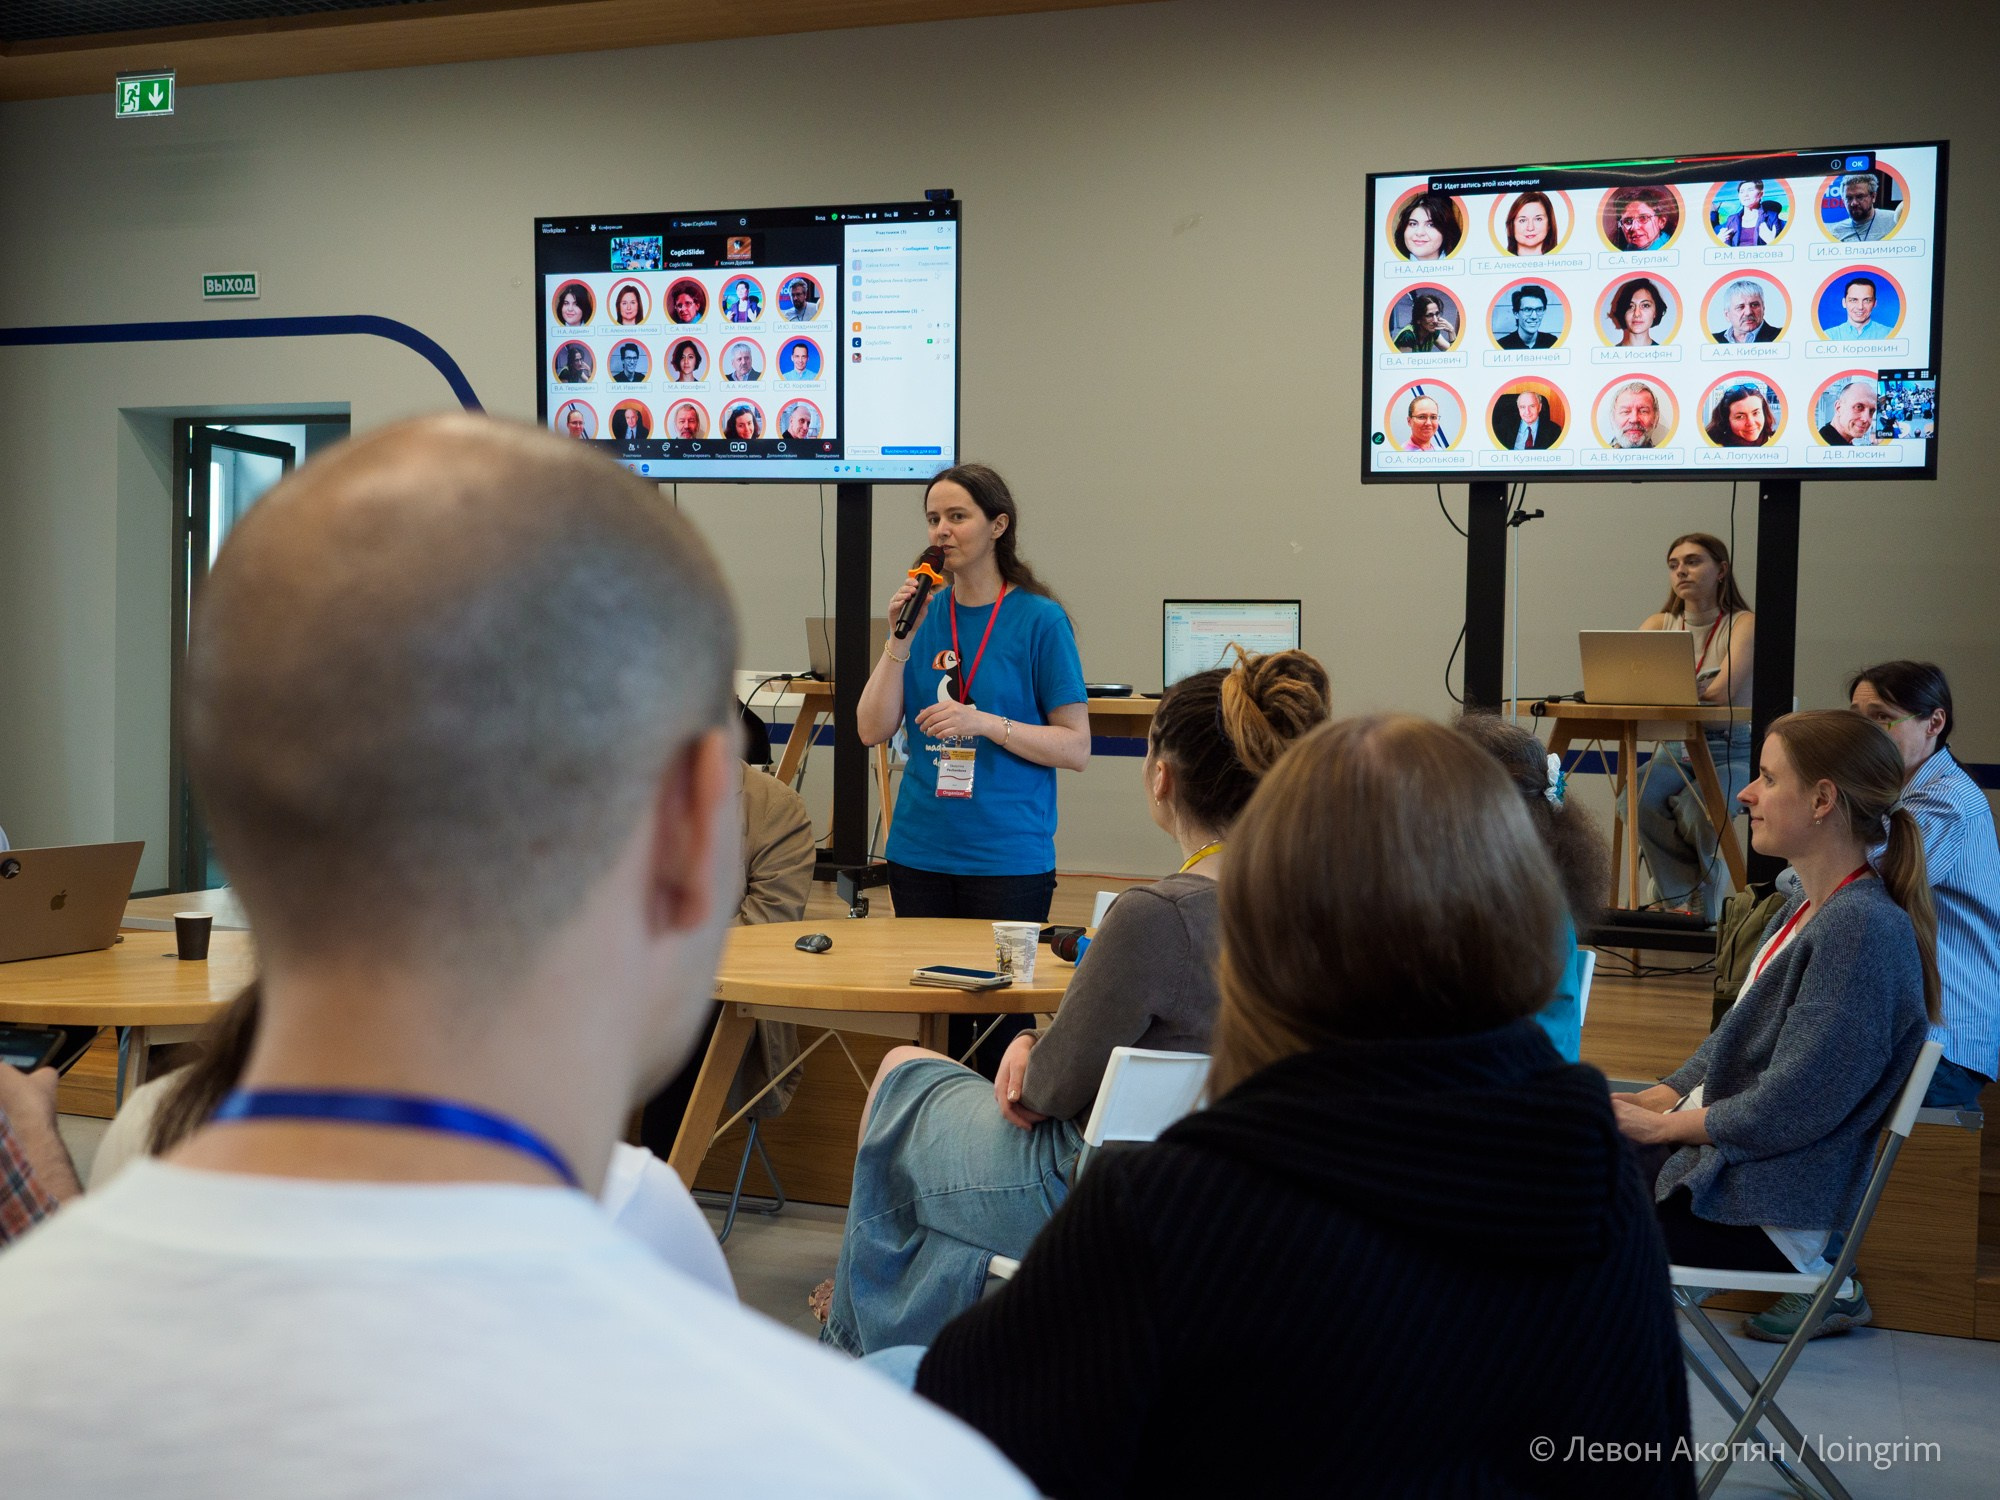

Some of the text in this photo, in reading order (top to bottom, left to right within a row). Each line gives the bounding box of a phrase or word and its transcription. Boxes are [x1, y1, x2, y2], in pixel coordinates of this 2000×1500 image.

[1444, 182, 1459, 190] Идет
[1497, 179, 1540, 188] конференции
[1738, 251, 1783, 259] Власова
[1845, 245, 1917, 256] Владимиров
[1631, 255, 1668, 265] Бурлак
[1416, 265, 1454, 274] Адамян
[1494, 260, 1583, 270] Алексеева-Нилова
[206, 278, 254, 293] ВЫХОД
[1736, 347, 1777, 357] Кибрик
[1843, 345, 1898, 354] Коровкин
[1516, 353, 1560, 362] Иванчей
[1624, 350, 1672, 360] Иосифян
[1407, 356, 1461, 365] Гершкович
[1513, 455, 1561, 463] Кузнецов
[1612, 452, 1674, 463] Курганский
[1726, 452, 1779, 461] Лопухина
[1847, 451, 1886, 459] Люсин
[1407, 456, 1464, 464] Королькова
